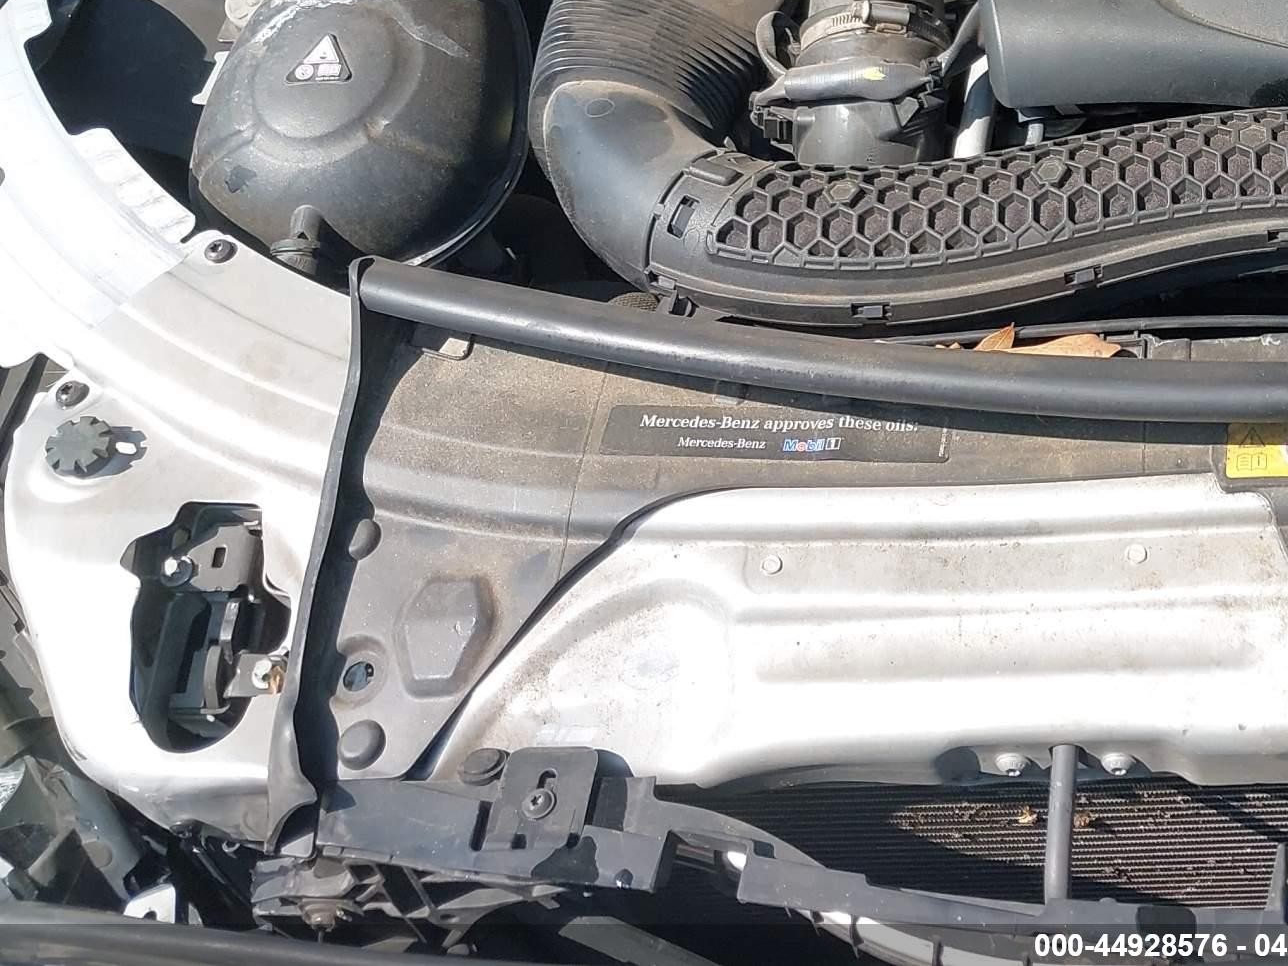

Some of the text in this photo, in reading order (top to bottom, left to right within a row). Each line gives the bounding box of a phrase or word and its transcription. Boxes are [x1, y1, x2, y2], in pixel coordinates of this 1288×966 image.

[639, 414, 761, 430] Mercedes-Benz
[763, 417, 834, 433] approves
[838, 415, 882, 431] these
[677, 436, 767, 449] Mercedes-Benz
[783, 438, 826, 452] Mobil
